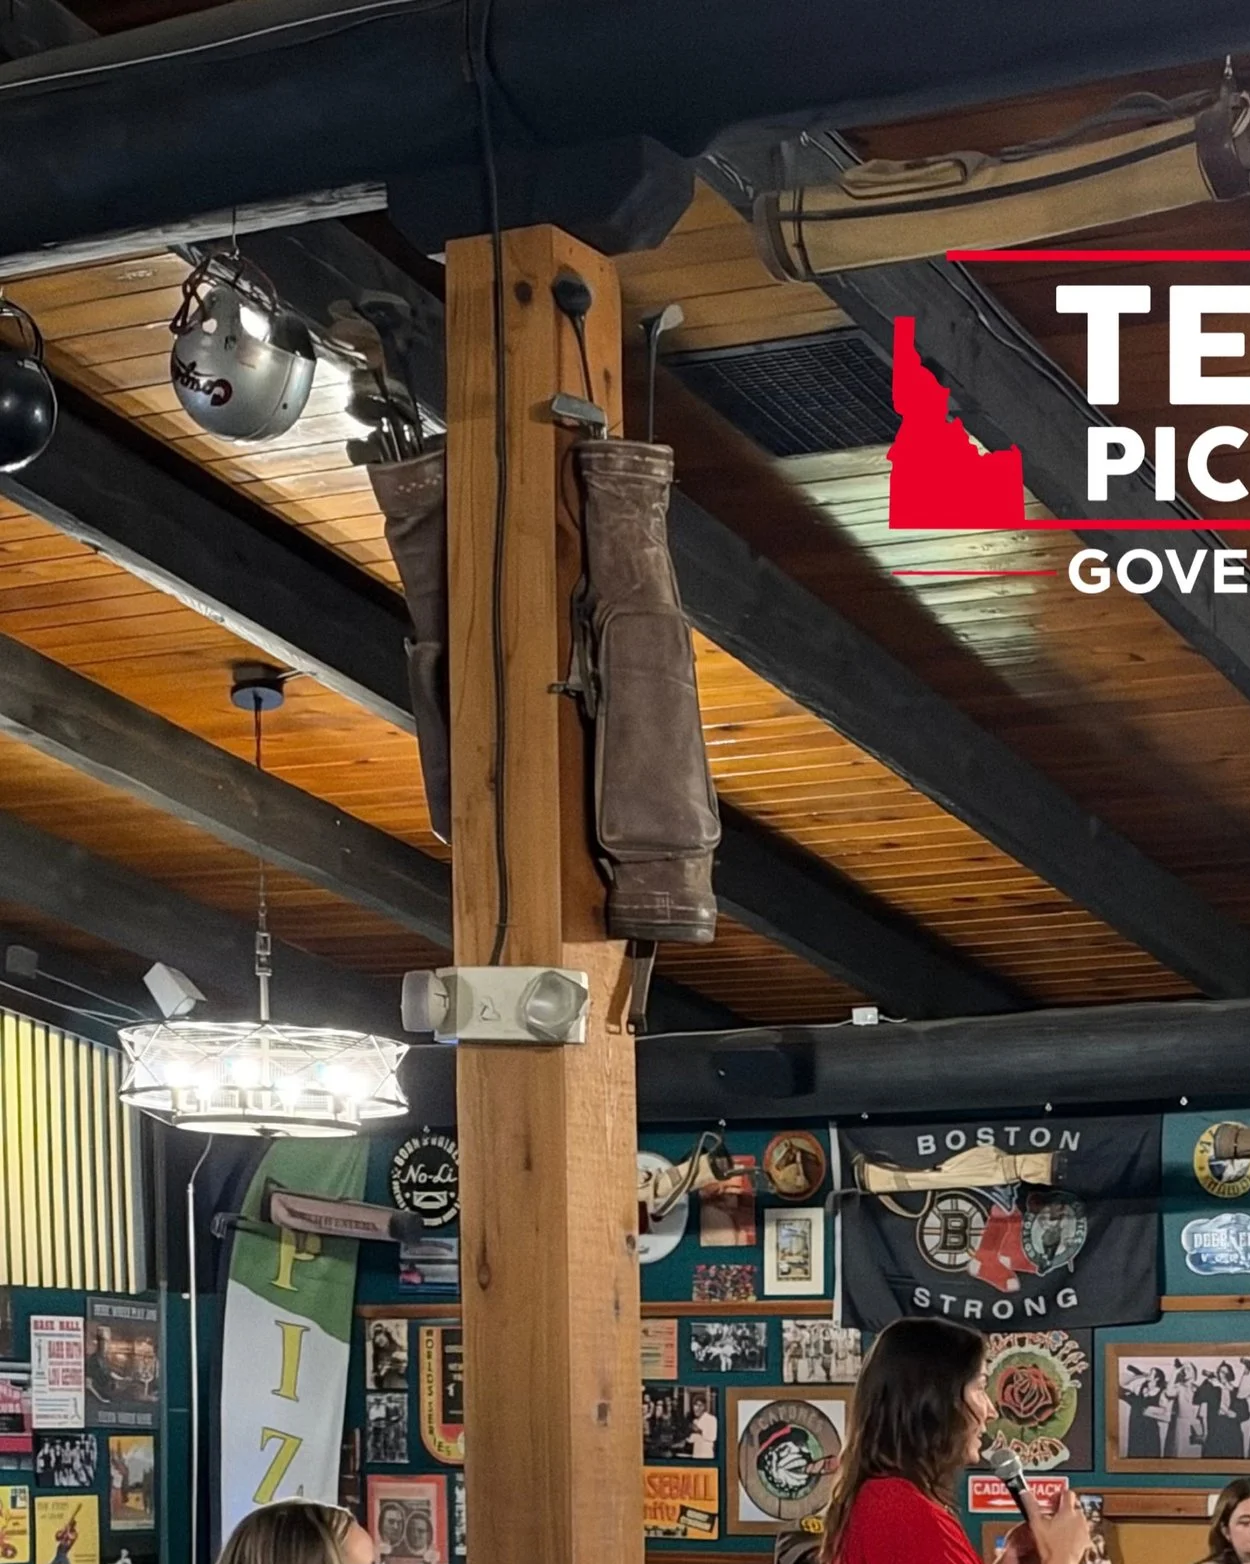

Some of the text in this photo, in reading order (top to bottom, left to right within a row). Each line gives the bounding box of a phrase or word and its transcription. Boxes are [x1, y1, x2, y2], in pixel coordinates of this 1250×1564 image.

[917, 1127, 1081, 1155] BOSTON
[400, 1163, 459, 1184] No-Li
[913, 1286, 1079, 1320] STRONG
